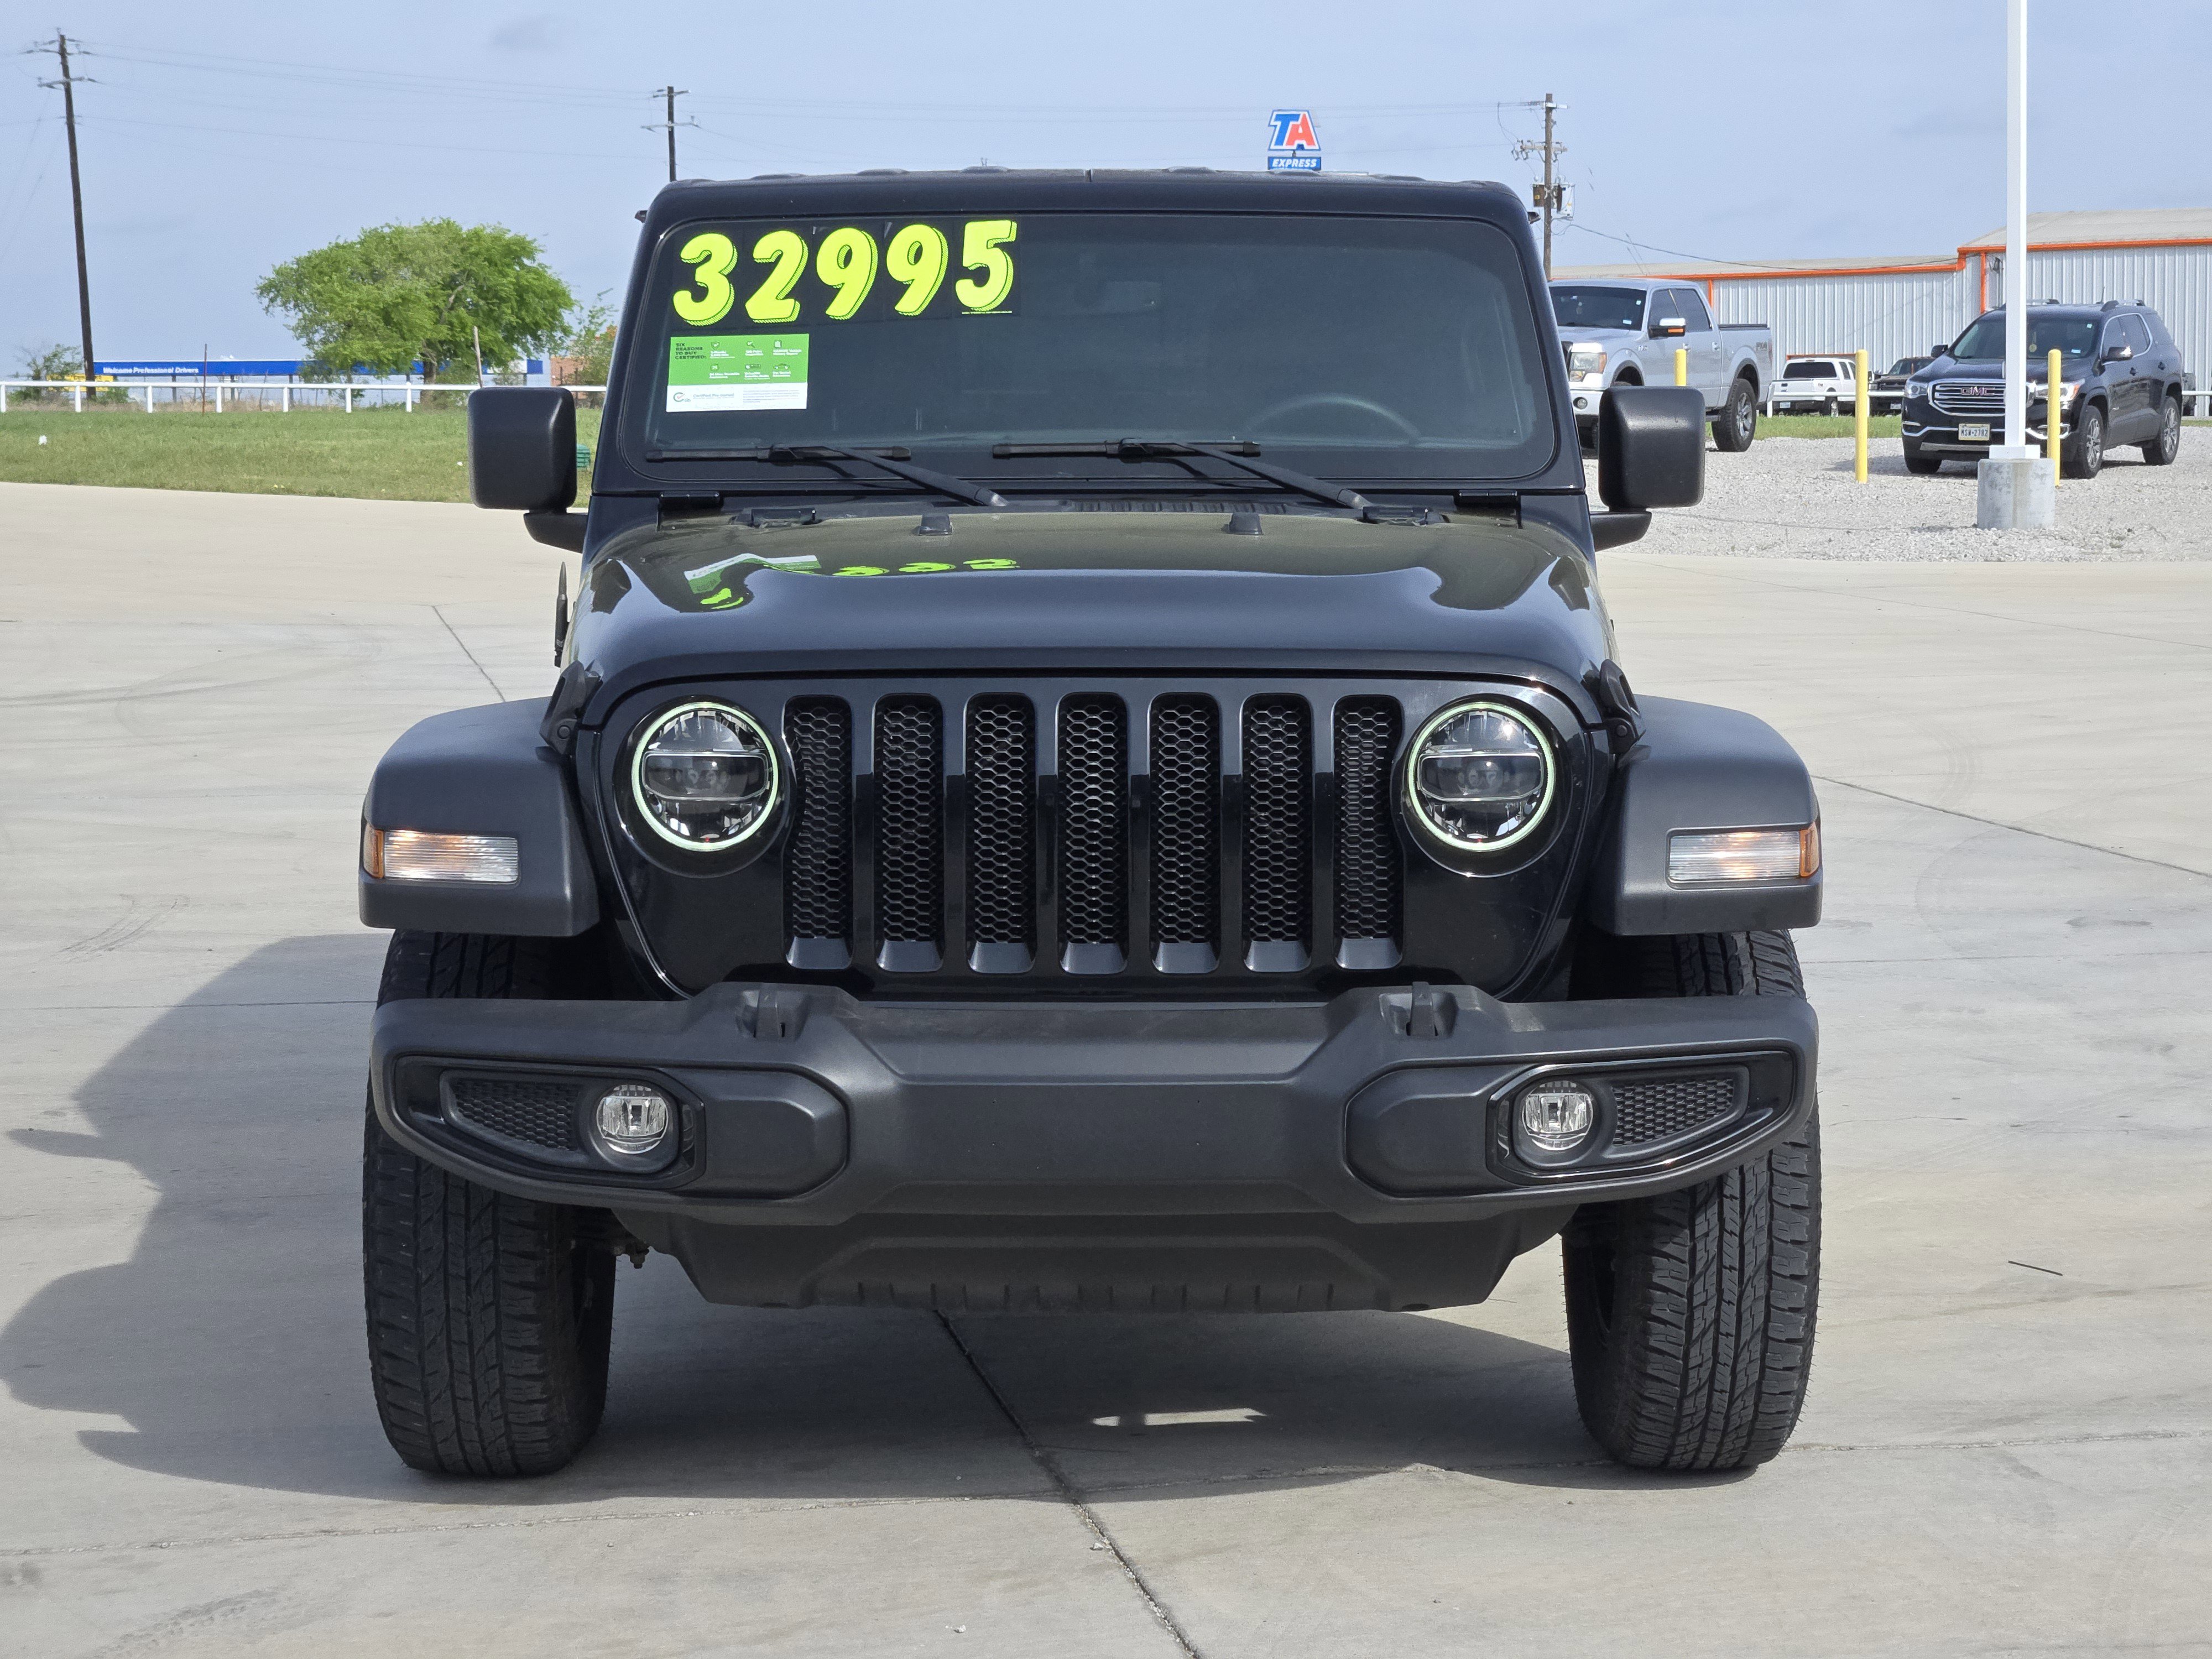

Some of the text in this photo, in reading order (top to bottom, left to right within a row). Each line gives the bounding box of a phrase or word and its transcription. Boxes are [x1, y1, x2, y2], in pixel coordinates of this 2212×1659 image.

[1272, 112, 1318, 148] TA
[1272, 158, 1317, 168] EXPRESS
[672, 220, 1018, 326] 32995
[1961, 386, 1995, 396] GMC
